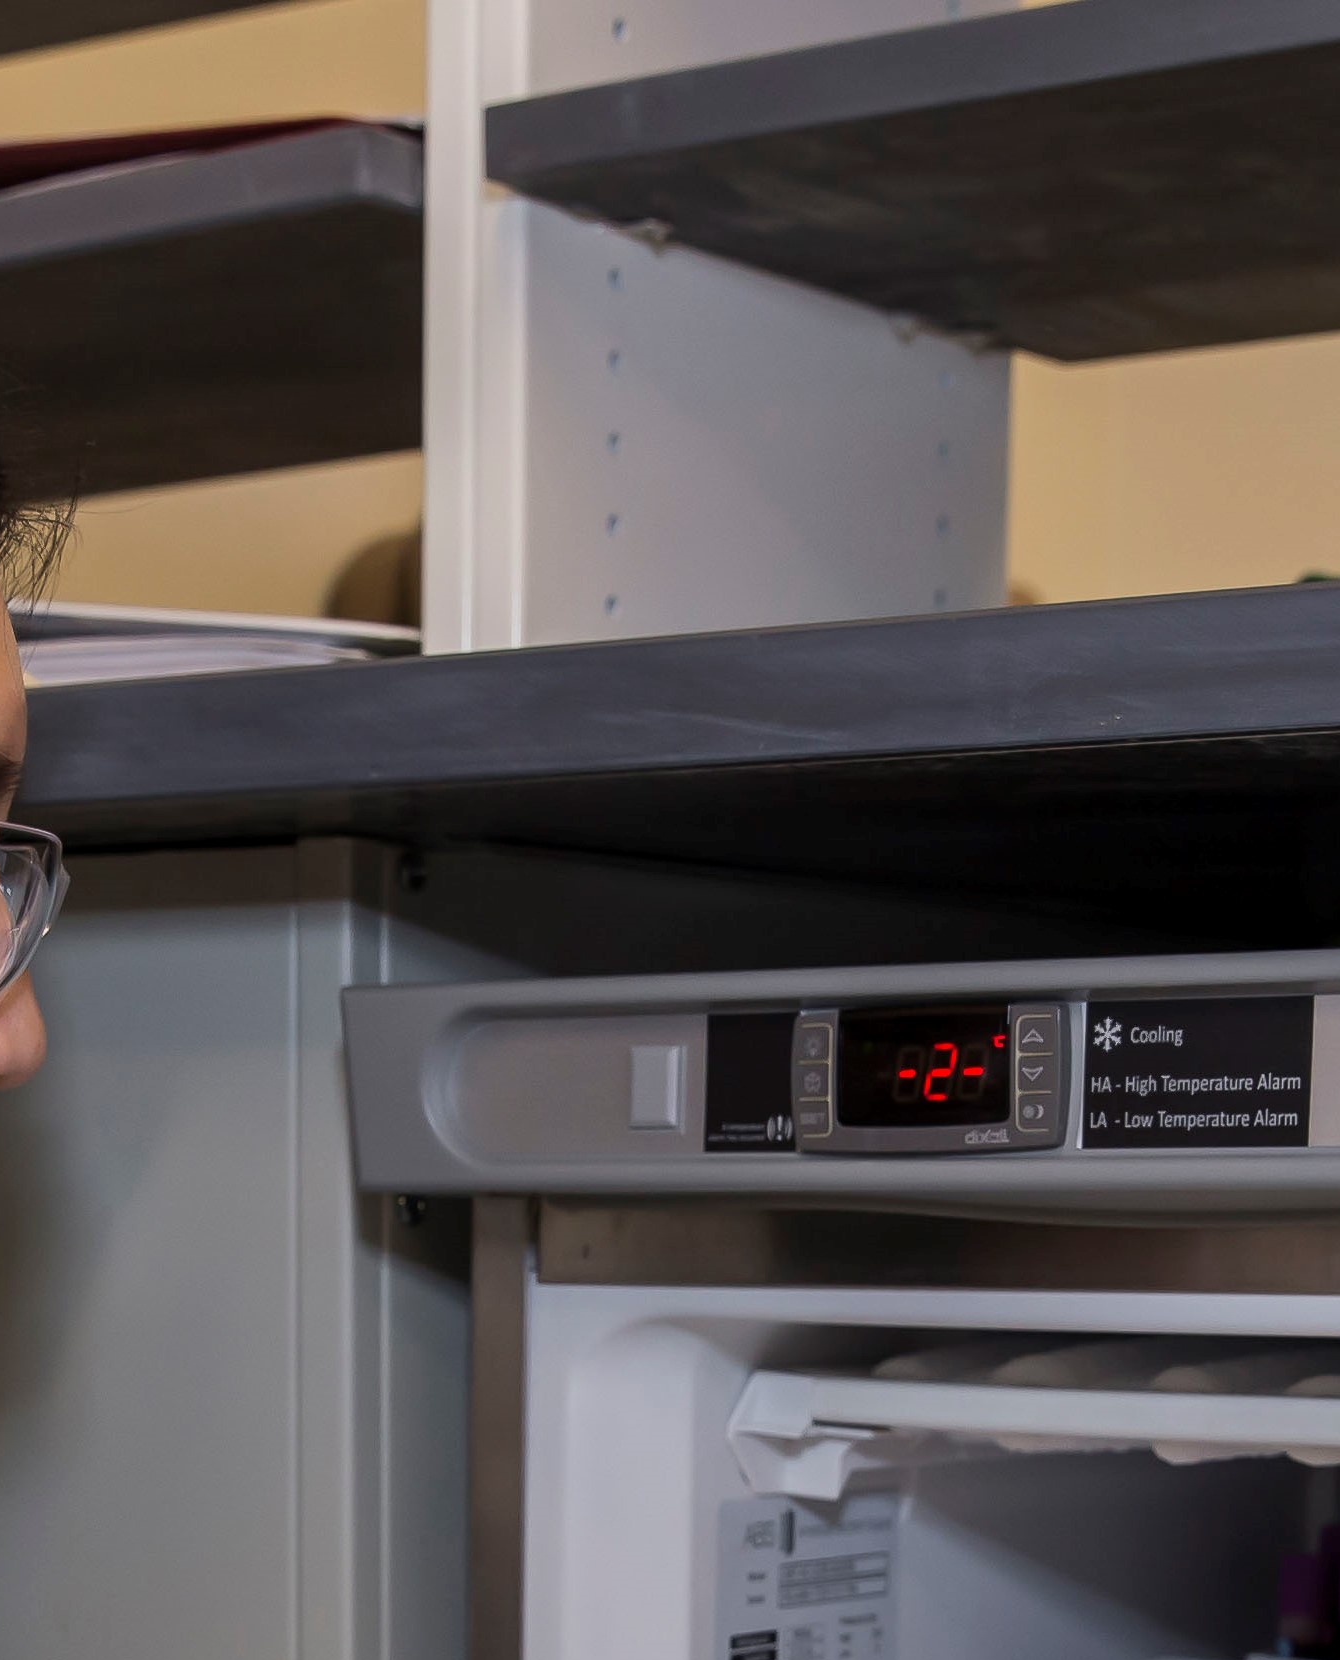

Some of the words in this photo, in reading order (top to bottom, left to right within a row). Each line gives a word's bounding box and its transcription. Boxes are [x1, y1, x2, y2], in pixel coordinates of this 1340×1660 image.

[1130, 1026, 1184, 1046] Cooling
[1090, 1076, 1111, 1093] HA
[1125, 1076, 1157, 1097] High
[1161, 1074, 1253, 1096] Temperature
[1257, 1072, 1301, 1091] Alarm
[1089, 1111, 1107, 1129] LA
[1124, 1111, 1153, 1129] Low
[1158, 1110, 1250, 1131] Temperature
[1254, 1108, 1298, 1127] Alarm
